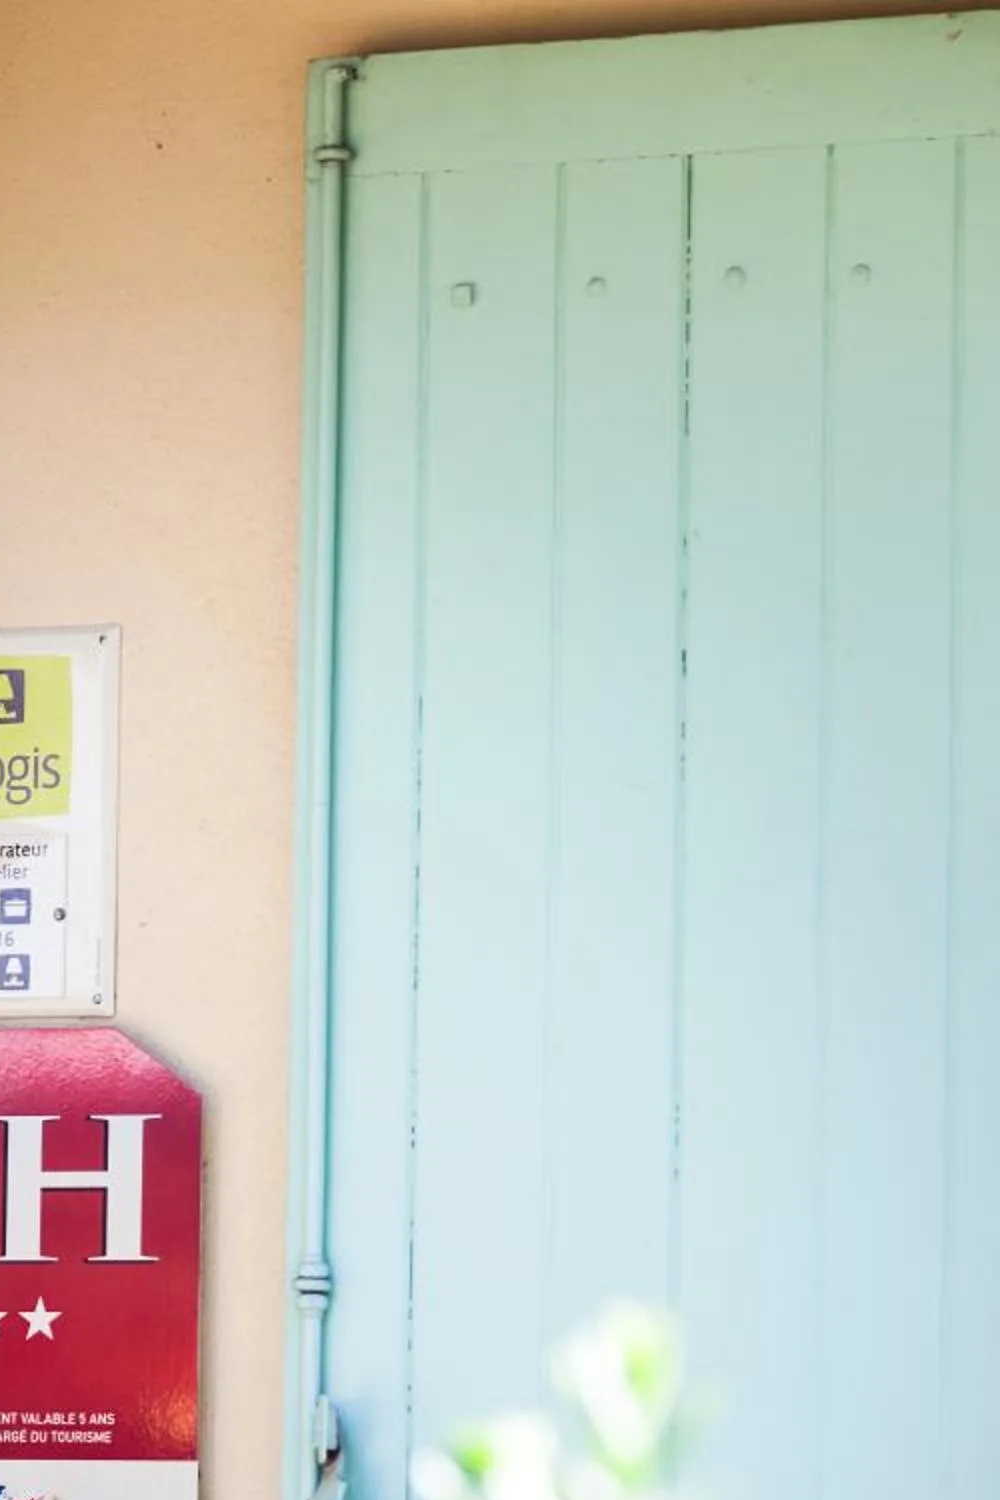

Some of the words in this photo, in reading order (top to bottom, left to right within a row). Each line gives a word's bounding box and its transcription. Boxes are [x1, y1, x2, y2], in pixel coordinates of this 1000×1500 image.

[20, 1412, 75, 1426] VALABLE
[78, 1412, 86, 1426] 5
[89, 1412, 116, 1426] ANS
[30, 1430, 47, 1443] DU
[51, 1430, 112, 1444] TOURISME
